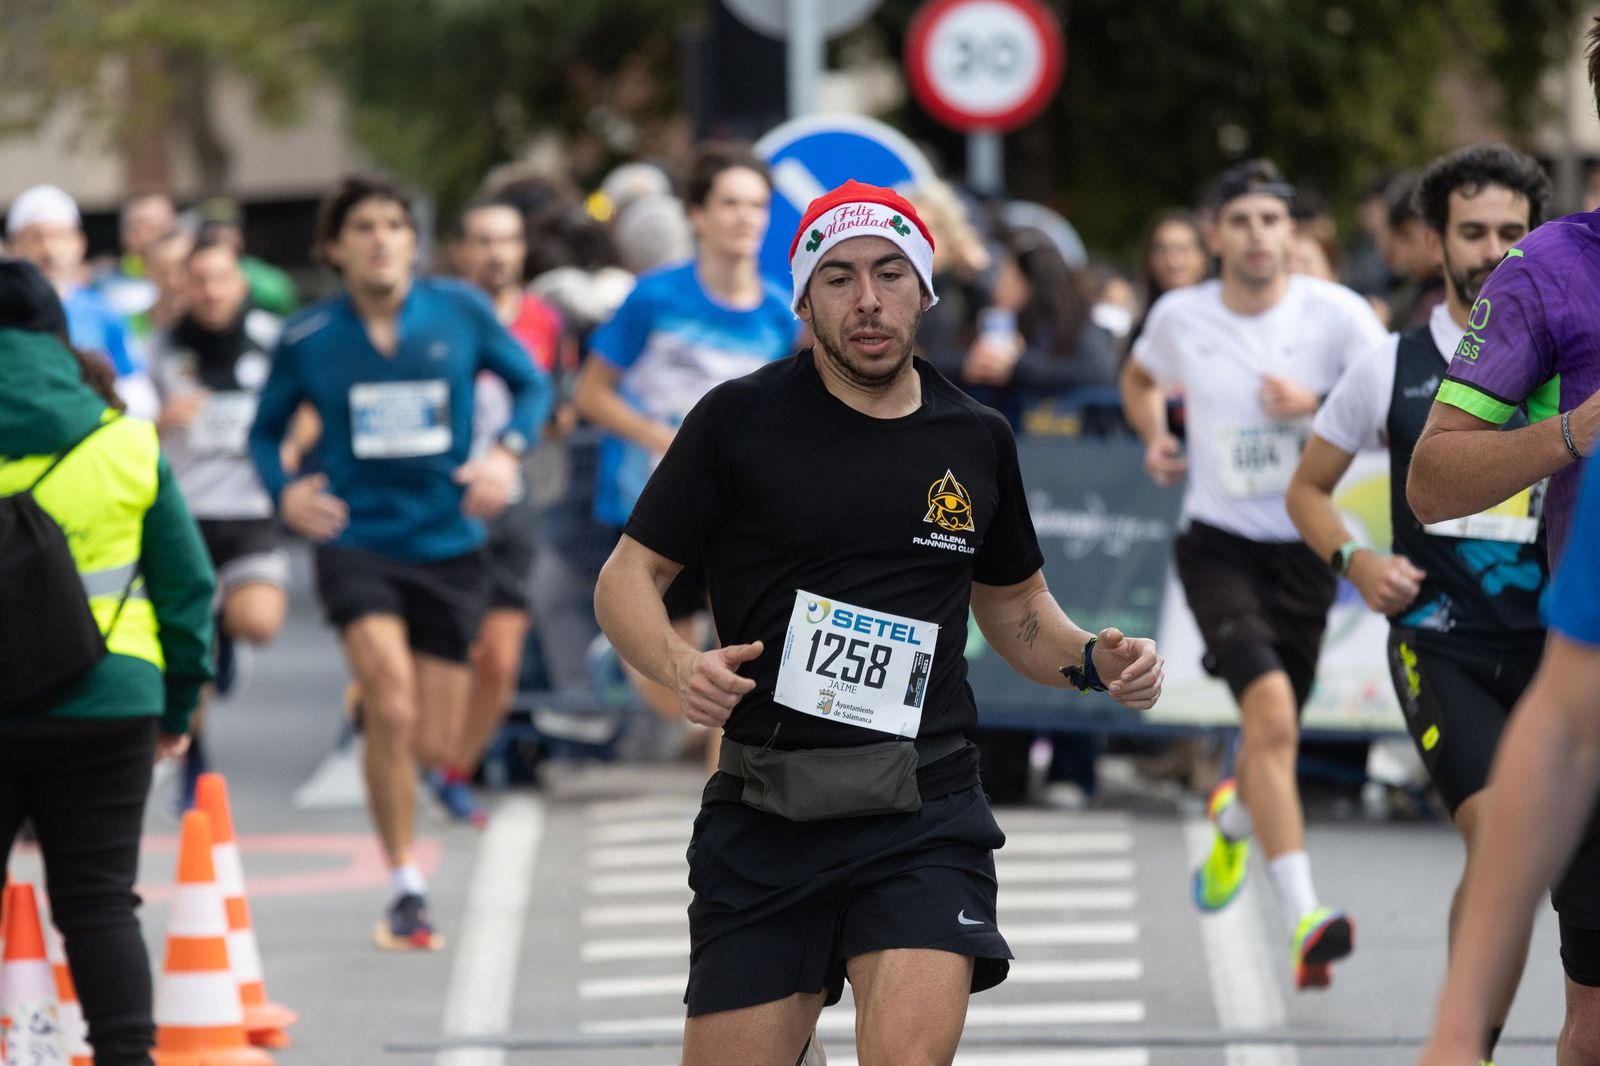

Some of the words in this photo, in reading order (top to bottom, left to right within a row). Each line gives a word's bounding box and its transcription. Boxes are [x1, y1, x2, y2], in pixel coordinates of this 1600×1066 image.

[834, 204, 875, 222] Feliz
[823, 213, 890, 238] Navidad
[912, 537, 957, 551] RUNNING
[957, 545, 975, 554] CLUB
[930, 532, 967, 545] GALENA
[831, 608, 921, 646] SETEL
[805, 629, 893, 690] 1258
[826, 679, 858, 695] JAIME
[835, 700, 874, 715] Ayuntamiento
[833, 709, 841, 717] de
[842, 711, 872, 724] Salamanca
